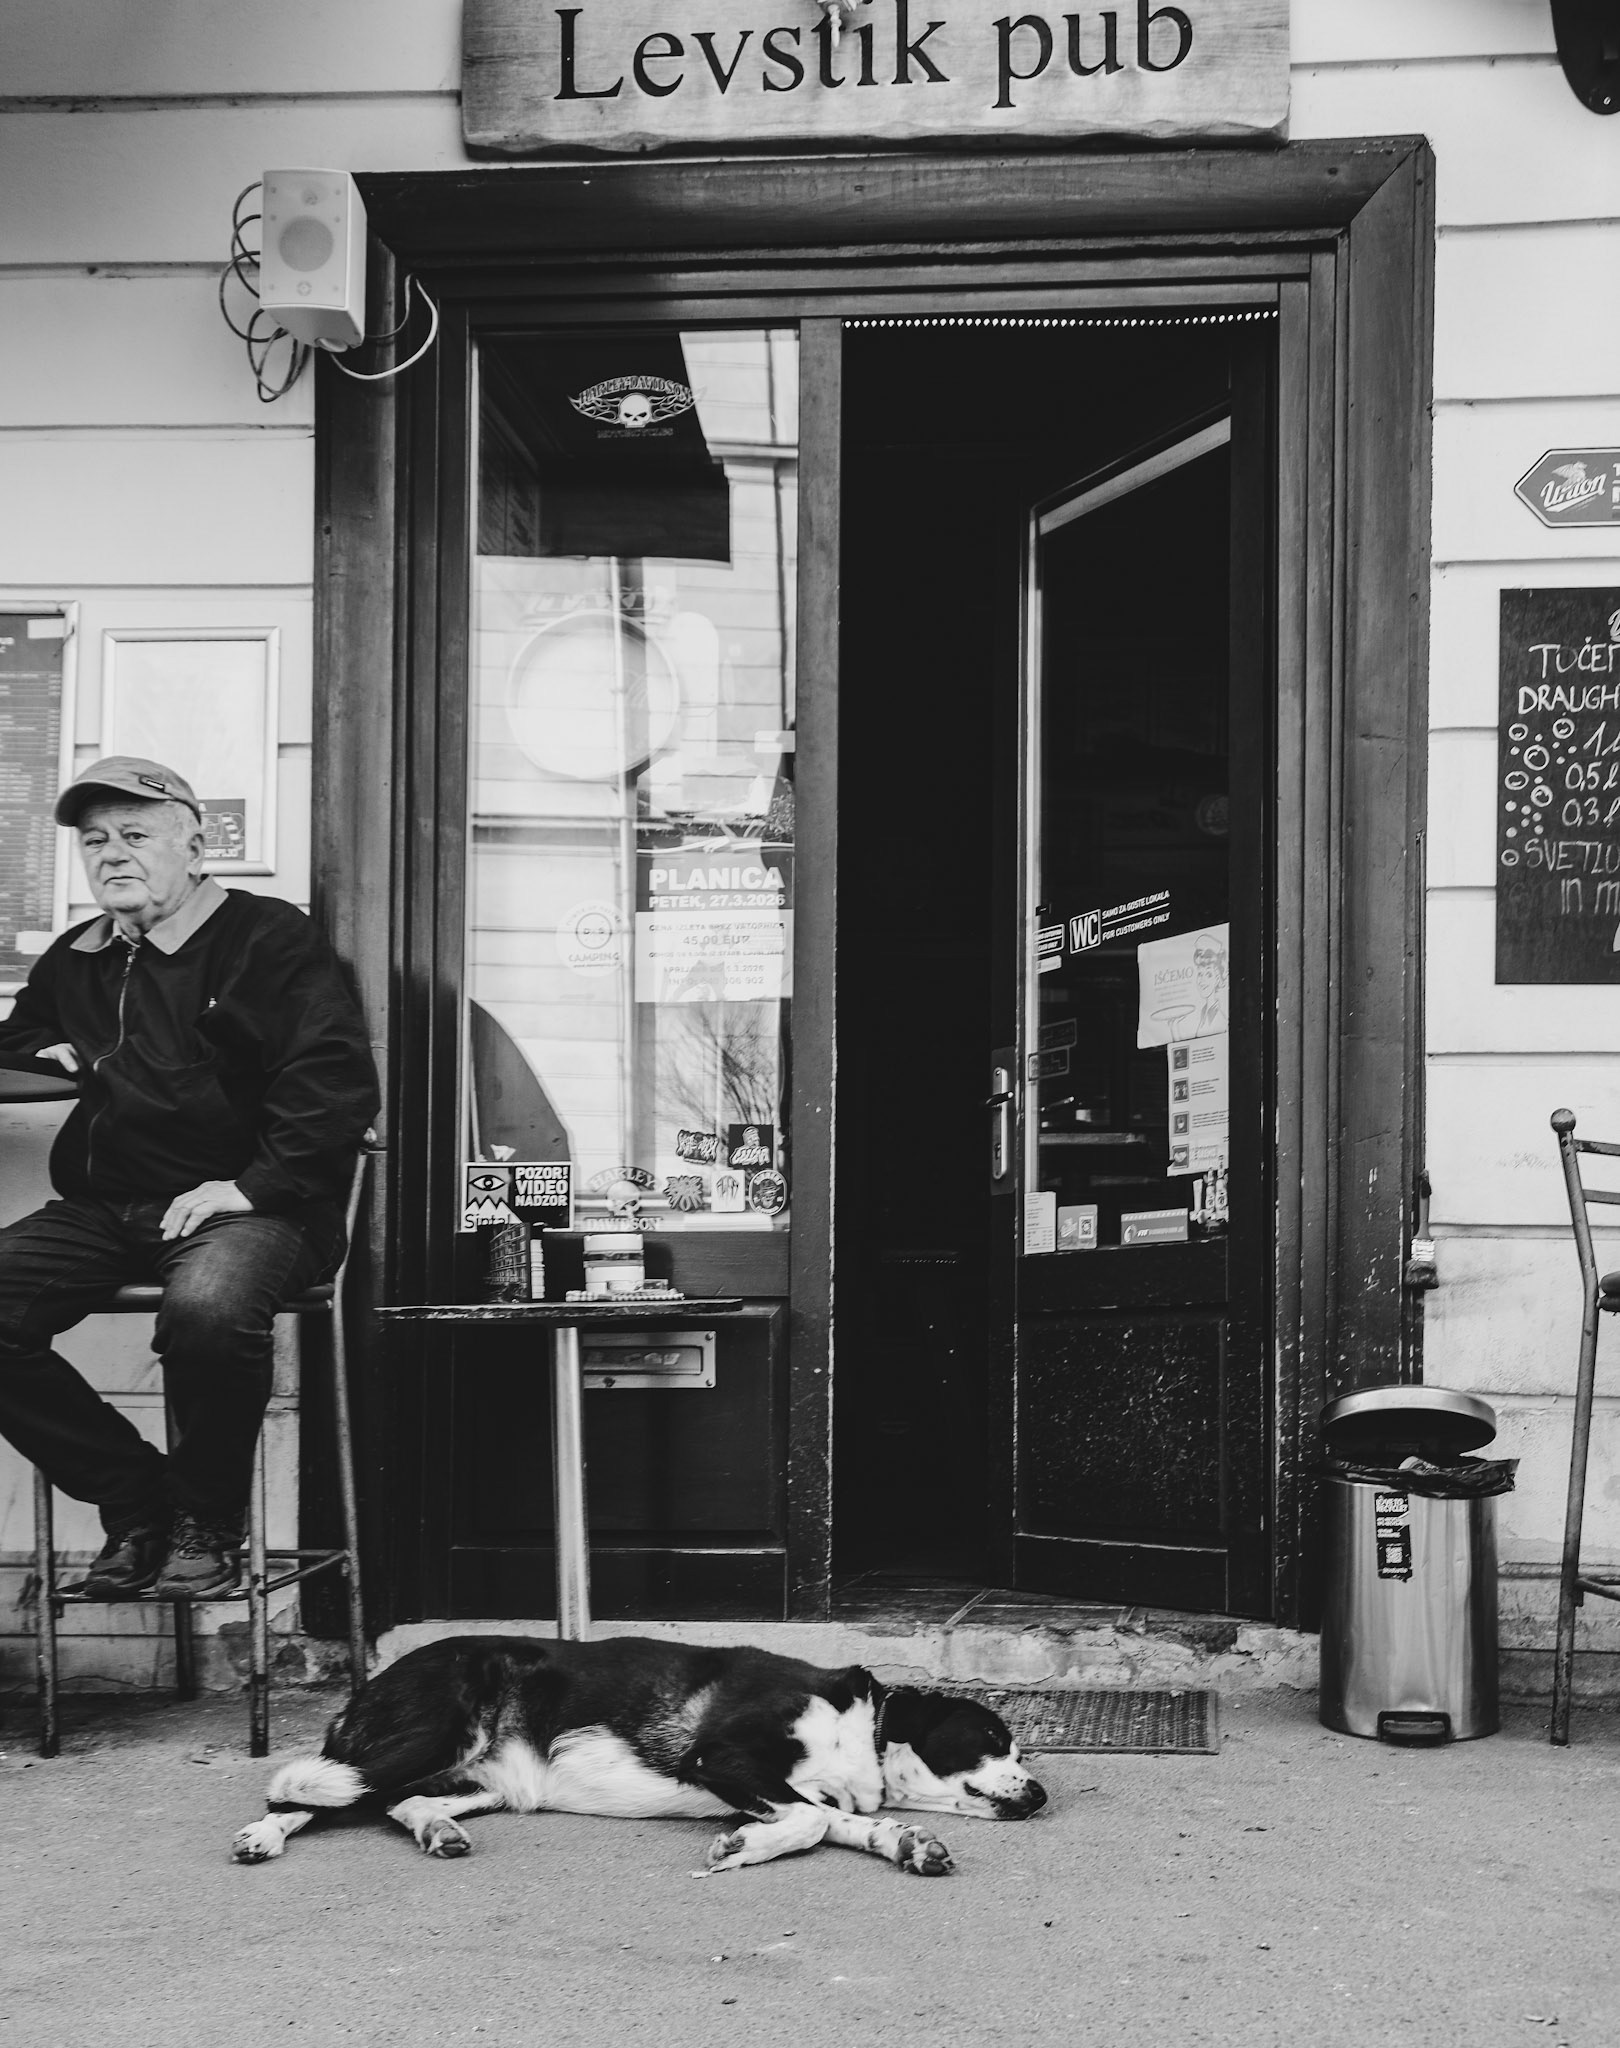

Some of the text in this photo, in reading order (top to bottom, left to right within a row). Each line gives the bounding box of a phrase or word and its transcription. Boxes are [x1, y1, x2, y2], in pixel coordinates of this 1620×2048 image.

[553, 0, 1195, 109] Levstik pub
[1540, 473, 1607, 508] Union
[1518, 683, 1620, 715] DRAUGH
[649, 866, 786, 891] PLANICA
[648, 893, 786, 909] PETEK, 27.3.2026
[1071, 913, 1098, 950] WC
[1102, 929, 1115, 941] FOR
[1115, 917, 1153, 937] CUSTOMERS
[568, 952, 620, 962] CAMPING
[515, 1166, 568, 1180] POZOR!
[588, 1167, 656, 1190] HARLEY
[515, 1180, 568, 1194] VIDEO
[514, 1195, 568, 1207] NADZOR
